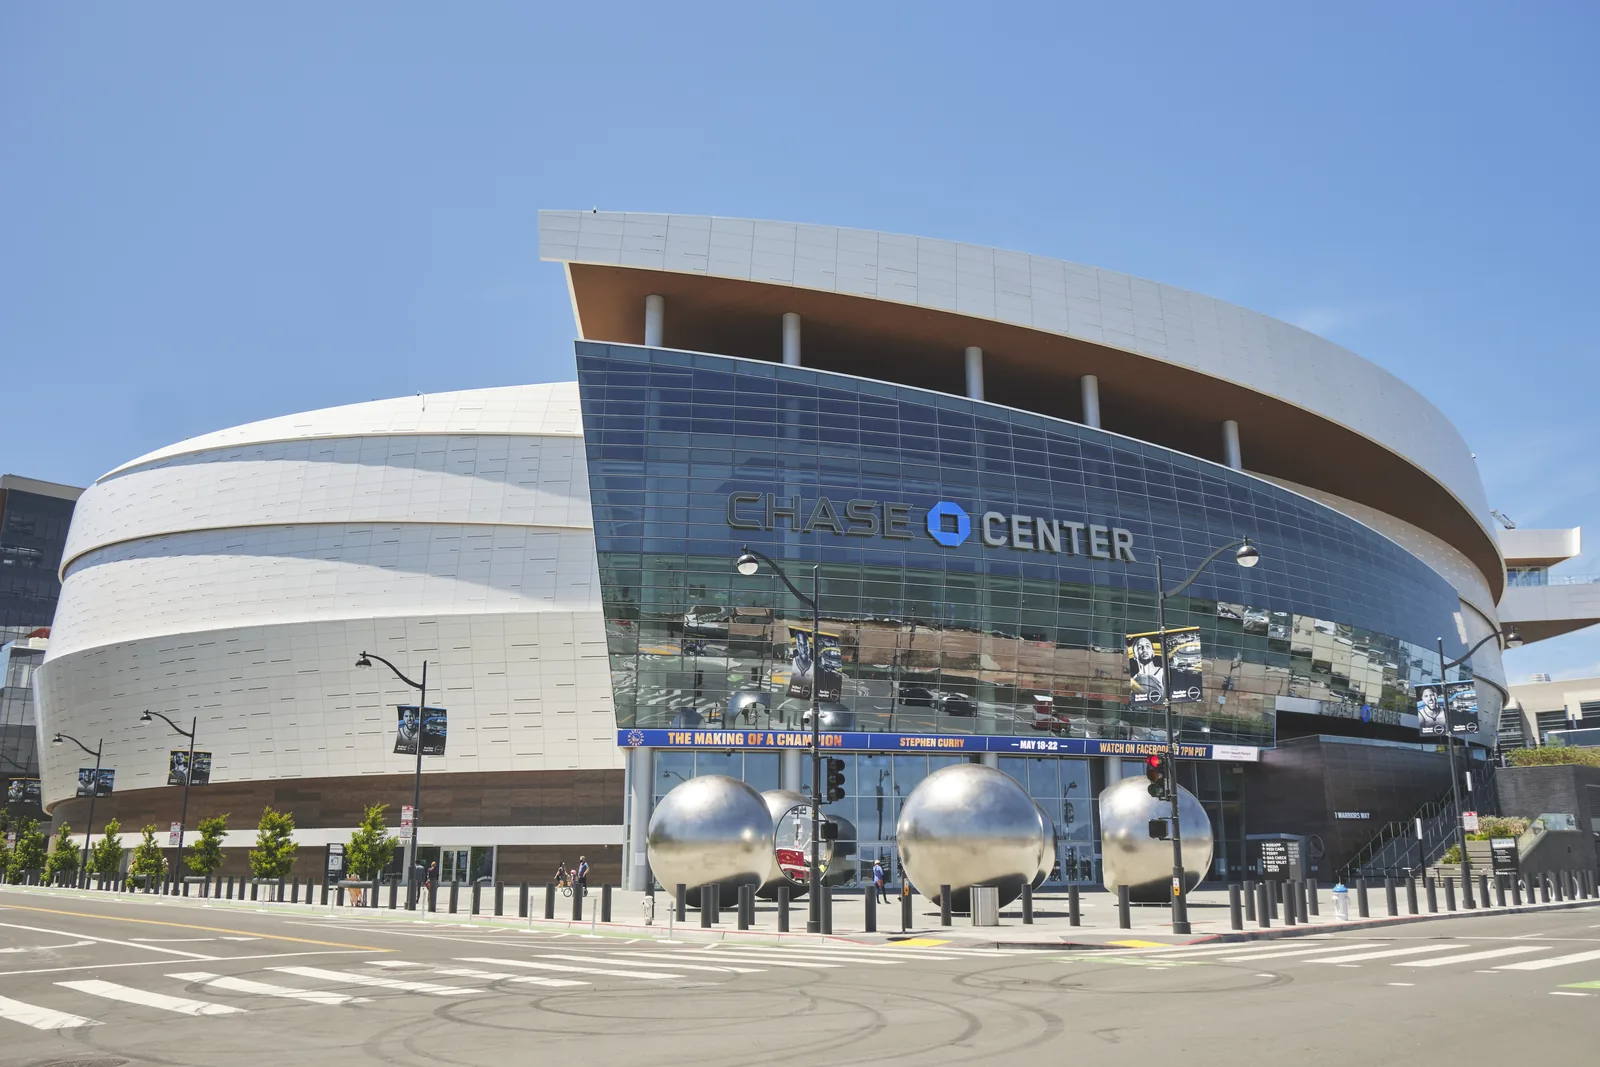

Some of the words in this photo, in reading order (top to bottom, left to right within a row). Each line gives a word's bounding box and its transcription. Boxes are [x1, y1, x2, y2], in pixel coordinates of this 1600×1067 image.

[727, 491, 916, 538] CHASE
[982, 511, 1137, 562] CENTER
[668, 732, 691, 745] THE
[694, 732, 744, 745] MAKING
[747, 733, 763, 745] OF
[766, 733, 774, 746] A
[777, 733, 842, 747] CHAMION
[900, 737, 936, 747] STEPHEN
[938, 738, 964, 748] CURRY
[1020, 740, 1036, 749] MAY
[1037, 741, 1058, 750] 18-22
[1100, 742, 1124, 754] WATCH
[1125, 743, 1135, 754] ON
[1180, 746, 1194, 756] 7PM
[1194, 747, 1206, 757] PDT
